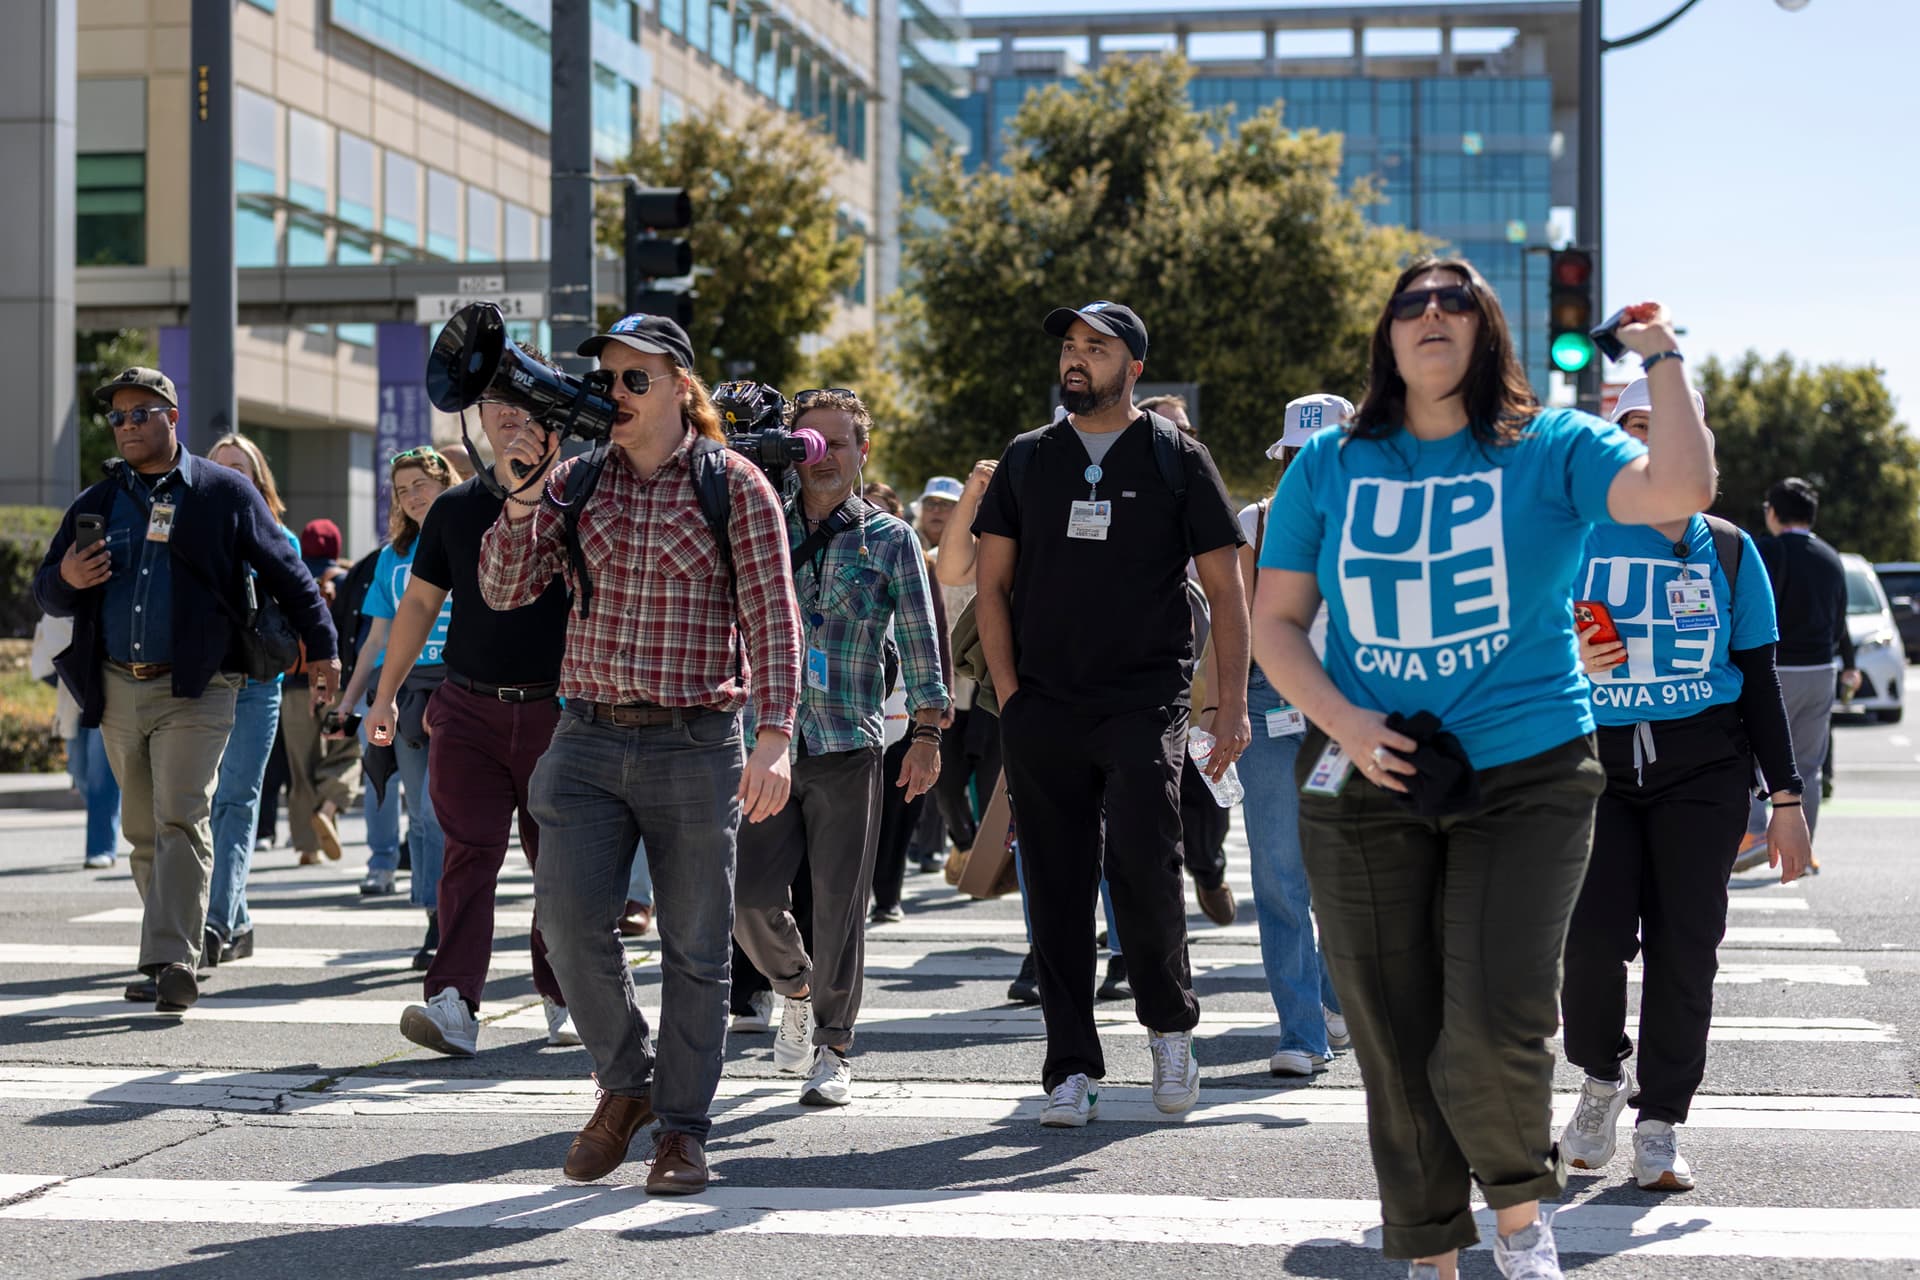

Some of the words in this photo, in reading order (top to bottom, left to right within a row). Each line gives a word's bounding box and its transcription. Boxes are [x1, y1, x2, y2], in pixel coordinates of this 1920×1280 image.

[500, 299, 523, 315] St
[1301, 406, 1321, 417] UP
[1301, 417, 1321, 427] TE
[1350, 478, 1495, 555] UP
[1344, 546, 1500, 641] TE
[1355, 646, 1428, 681] CWA
[1436, 633, 1510, 677] 9119
[1592, 685, 1655, 708] CWA
[1661, 680, 1713, 705] 9119
